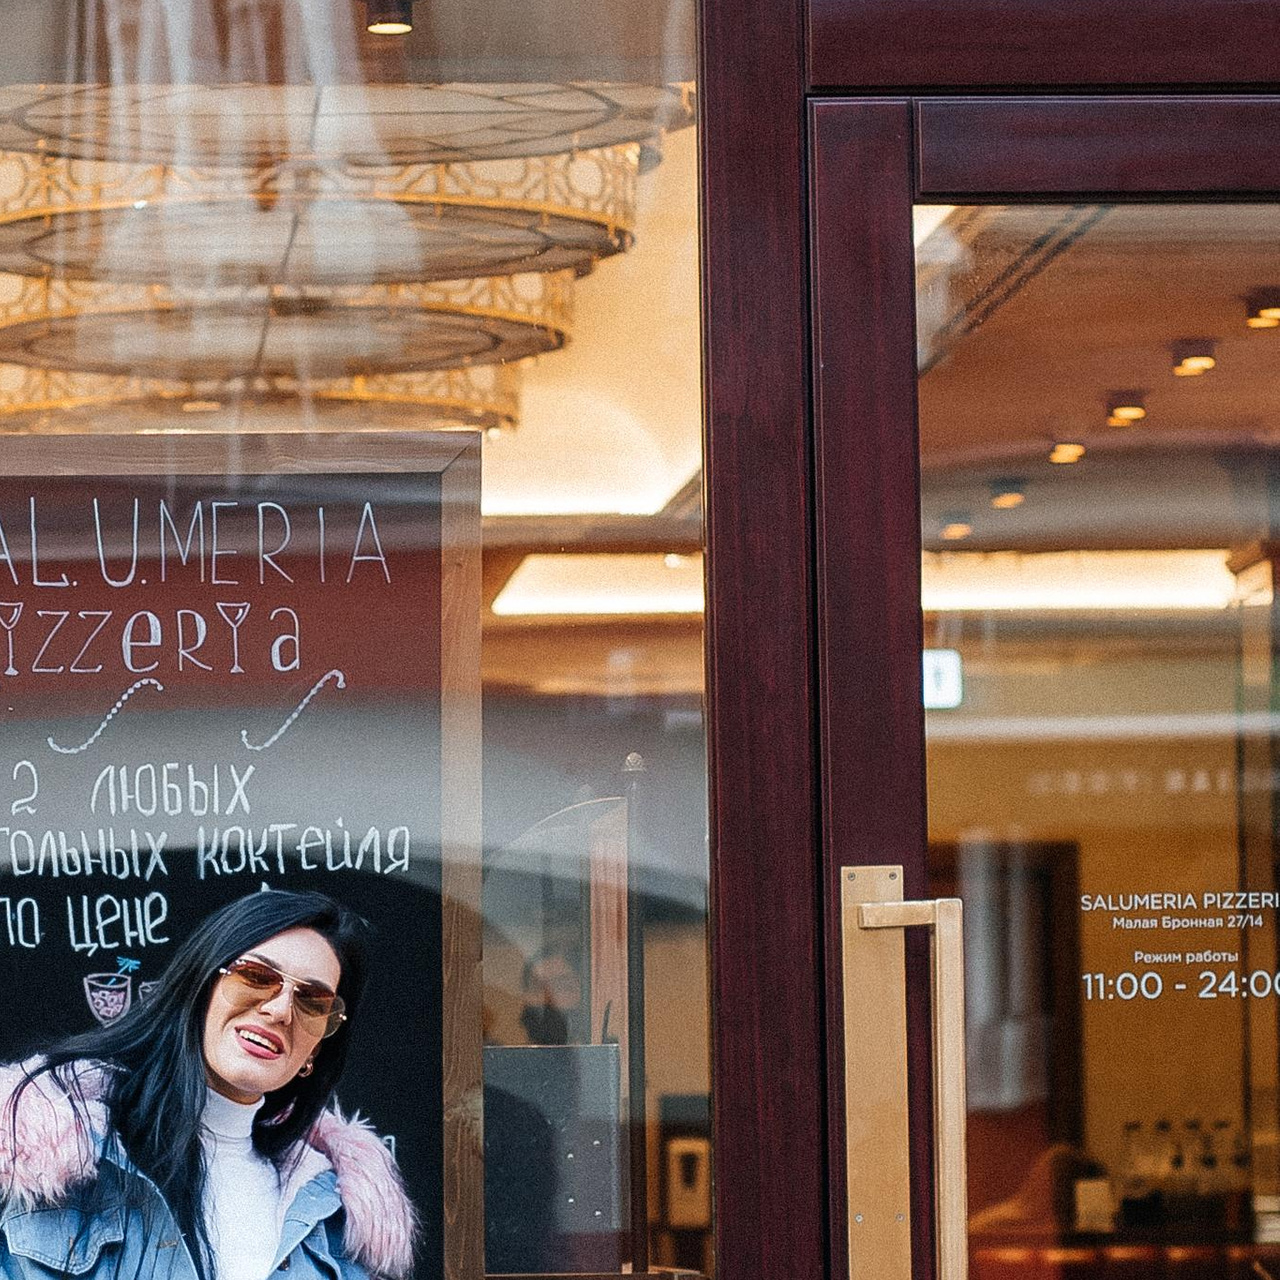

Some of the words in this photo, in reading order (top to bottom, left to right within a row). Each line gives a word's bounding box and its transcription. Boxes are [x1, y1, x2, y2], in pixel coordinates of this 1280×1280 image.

[10, 760, 40, 816] 2
[90, 762, 256, 817] ЛЮБЫХ
[1080, 893, 1198, 912] SALUMERIA
[1112, 916, 1158, 930] Малая
[1161, 915, 1224, 931] Бронная
[1227, 914, 1264, 930] 27/14
[1133, 950, 1182, 964] Режим
[1185, 949, 1239, 965] работы
[1081, 971, 1163, 1001] 11:00
